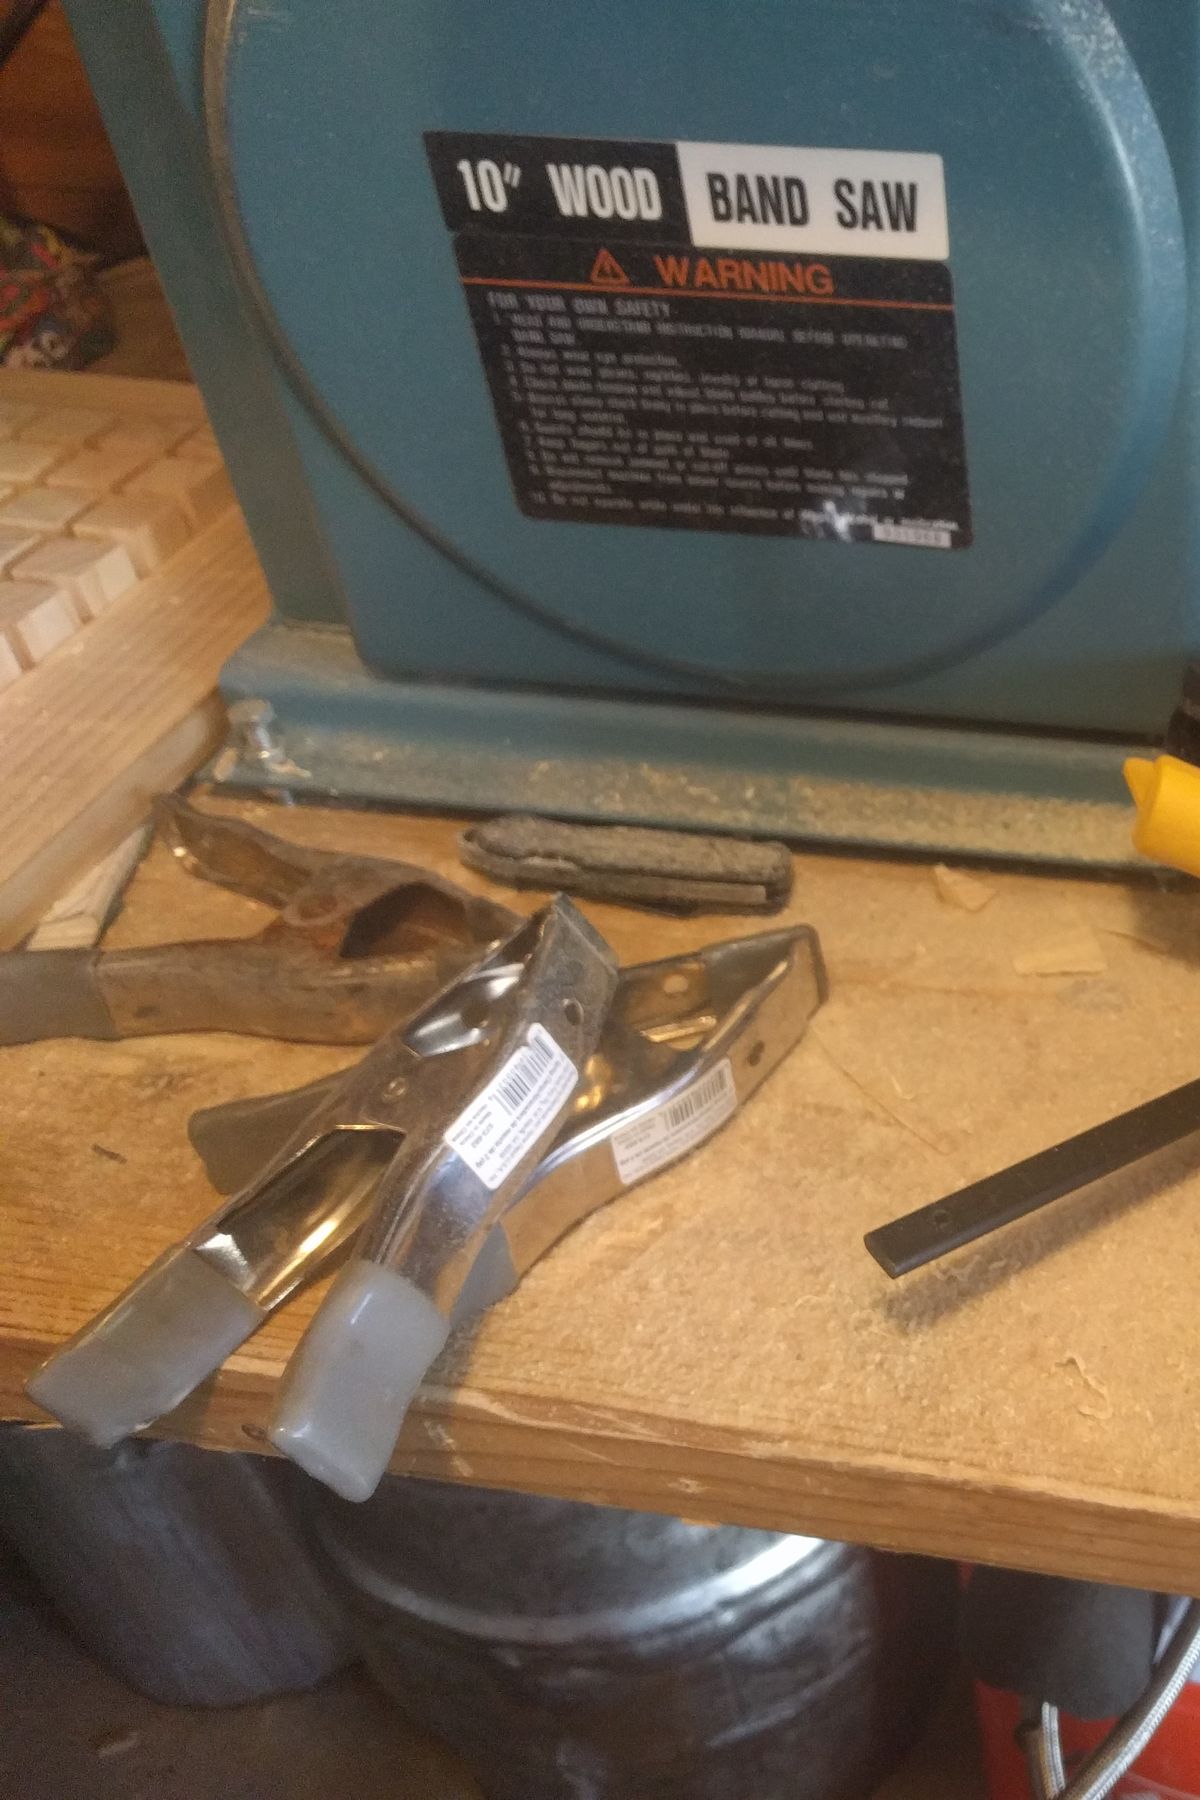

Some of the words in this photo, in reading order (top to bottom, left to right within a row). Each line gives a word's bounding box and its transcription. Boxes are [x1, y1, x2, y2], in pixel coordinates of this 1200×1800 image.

[545, 162, 663, 221] WOOD
[706, 171, 810, 227] BAND
[833, 177, 918, 233] SAW
[653, 254, 834, 295] WARNING
[614, 297, 671, 318] SAFETY
